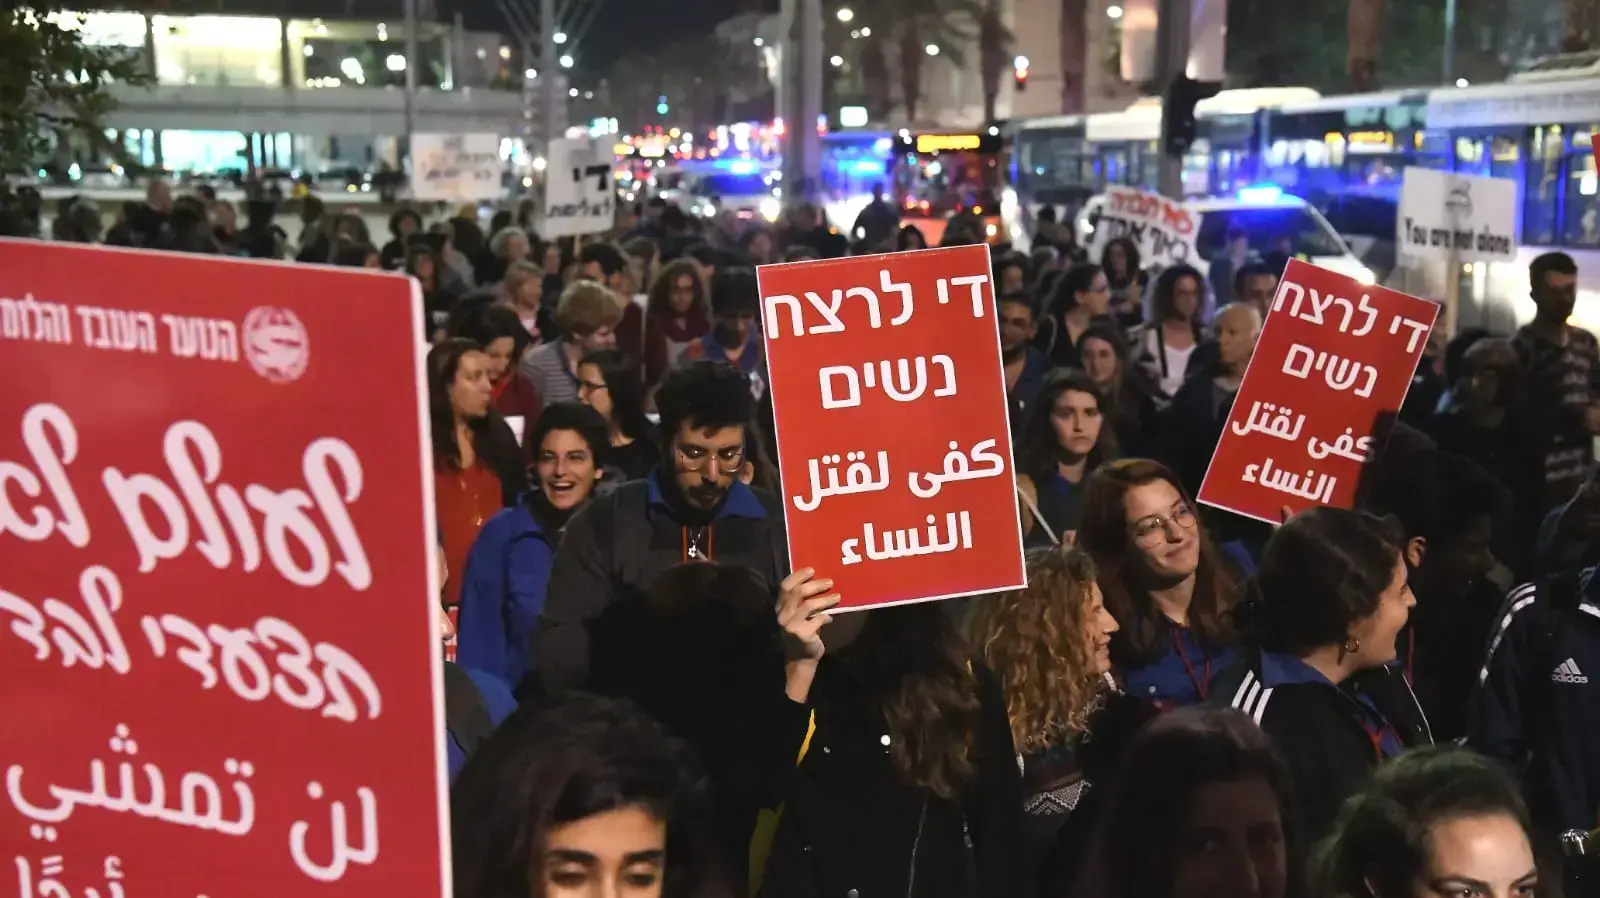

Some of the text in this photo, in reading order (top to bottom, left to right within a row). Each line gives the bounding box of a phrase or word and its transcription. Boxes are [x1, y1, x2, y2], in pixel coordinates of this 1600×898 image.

[572, 164, 611, 192] די
[1404, 217, 1511, 254] You are not alone
[74, 305, 157, 354] העובד
[764, 269, 989, 340] די לרצח
[1272, 280, 1429, 354] די לרצח
[161, 314, 240, 363] הנוער
[818, 354, 957, 410] נשים
[1281, 343, 1379, 398] נשים
[1231, 401, 1306, 441] لقتل
[792, 438, 1005, 512] كفى لقتل
[1241, 457, 1337, 504] النساء
[102, 419, 372, 591] לעולם
[841, 510, 973, 566] النساء
[0, 565, 381, 722] תצעדי לבד
[1551, 673, 1589, 685] adidas
[6, 723, 379, 881] لن تمشي
